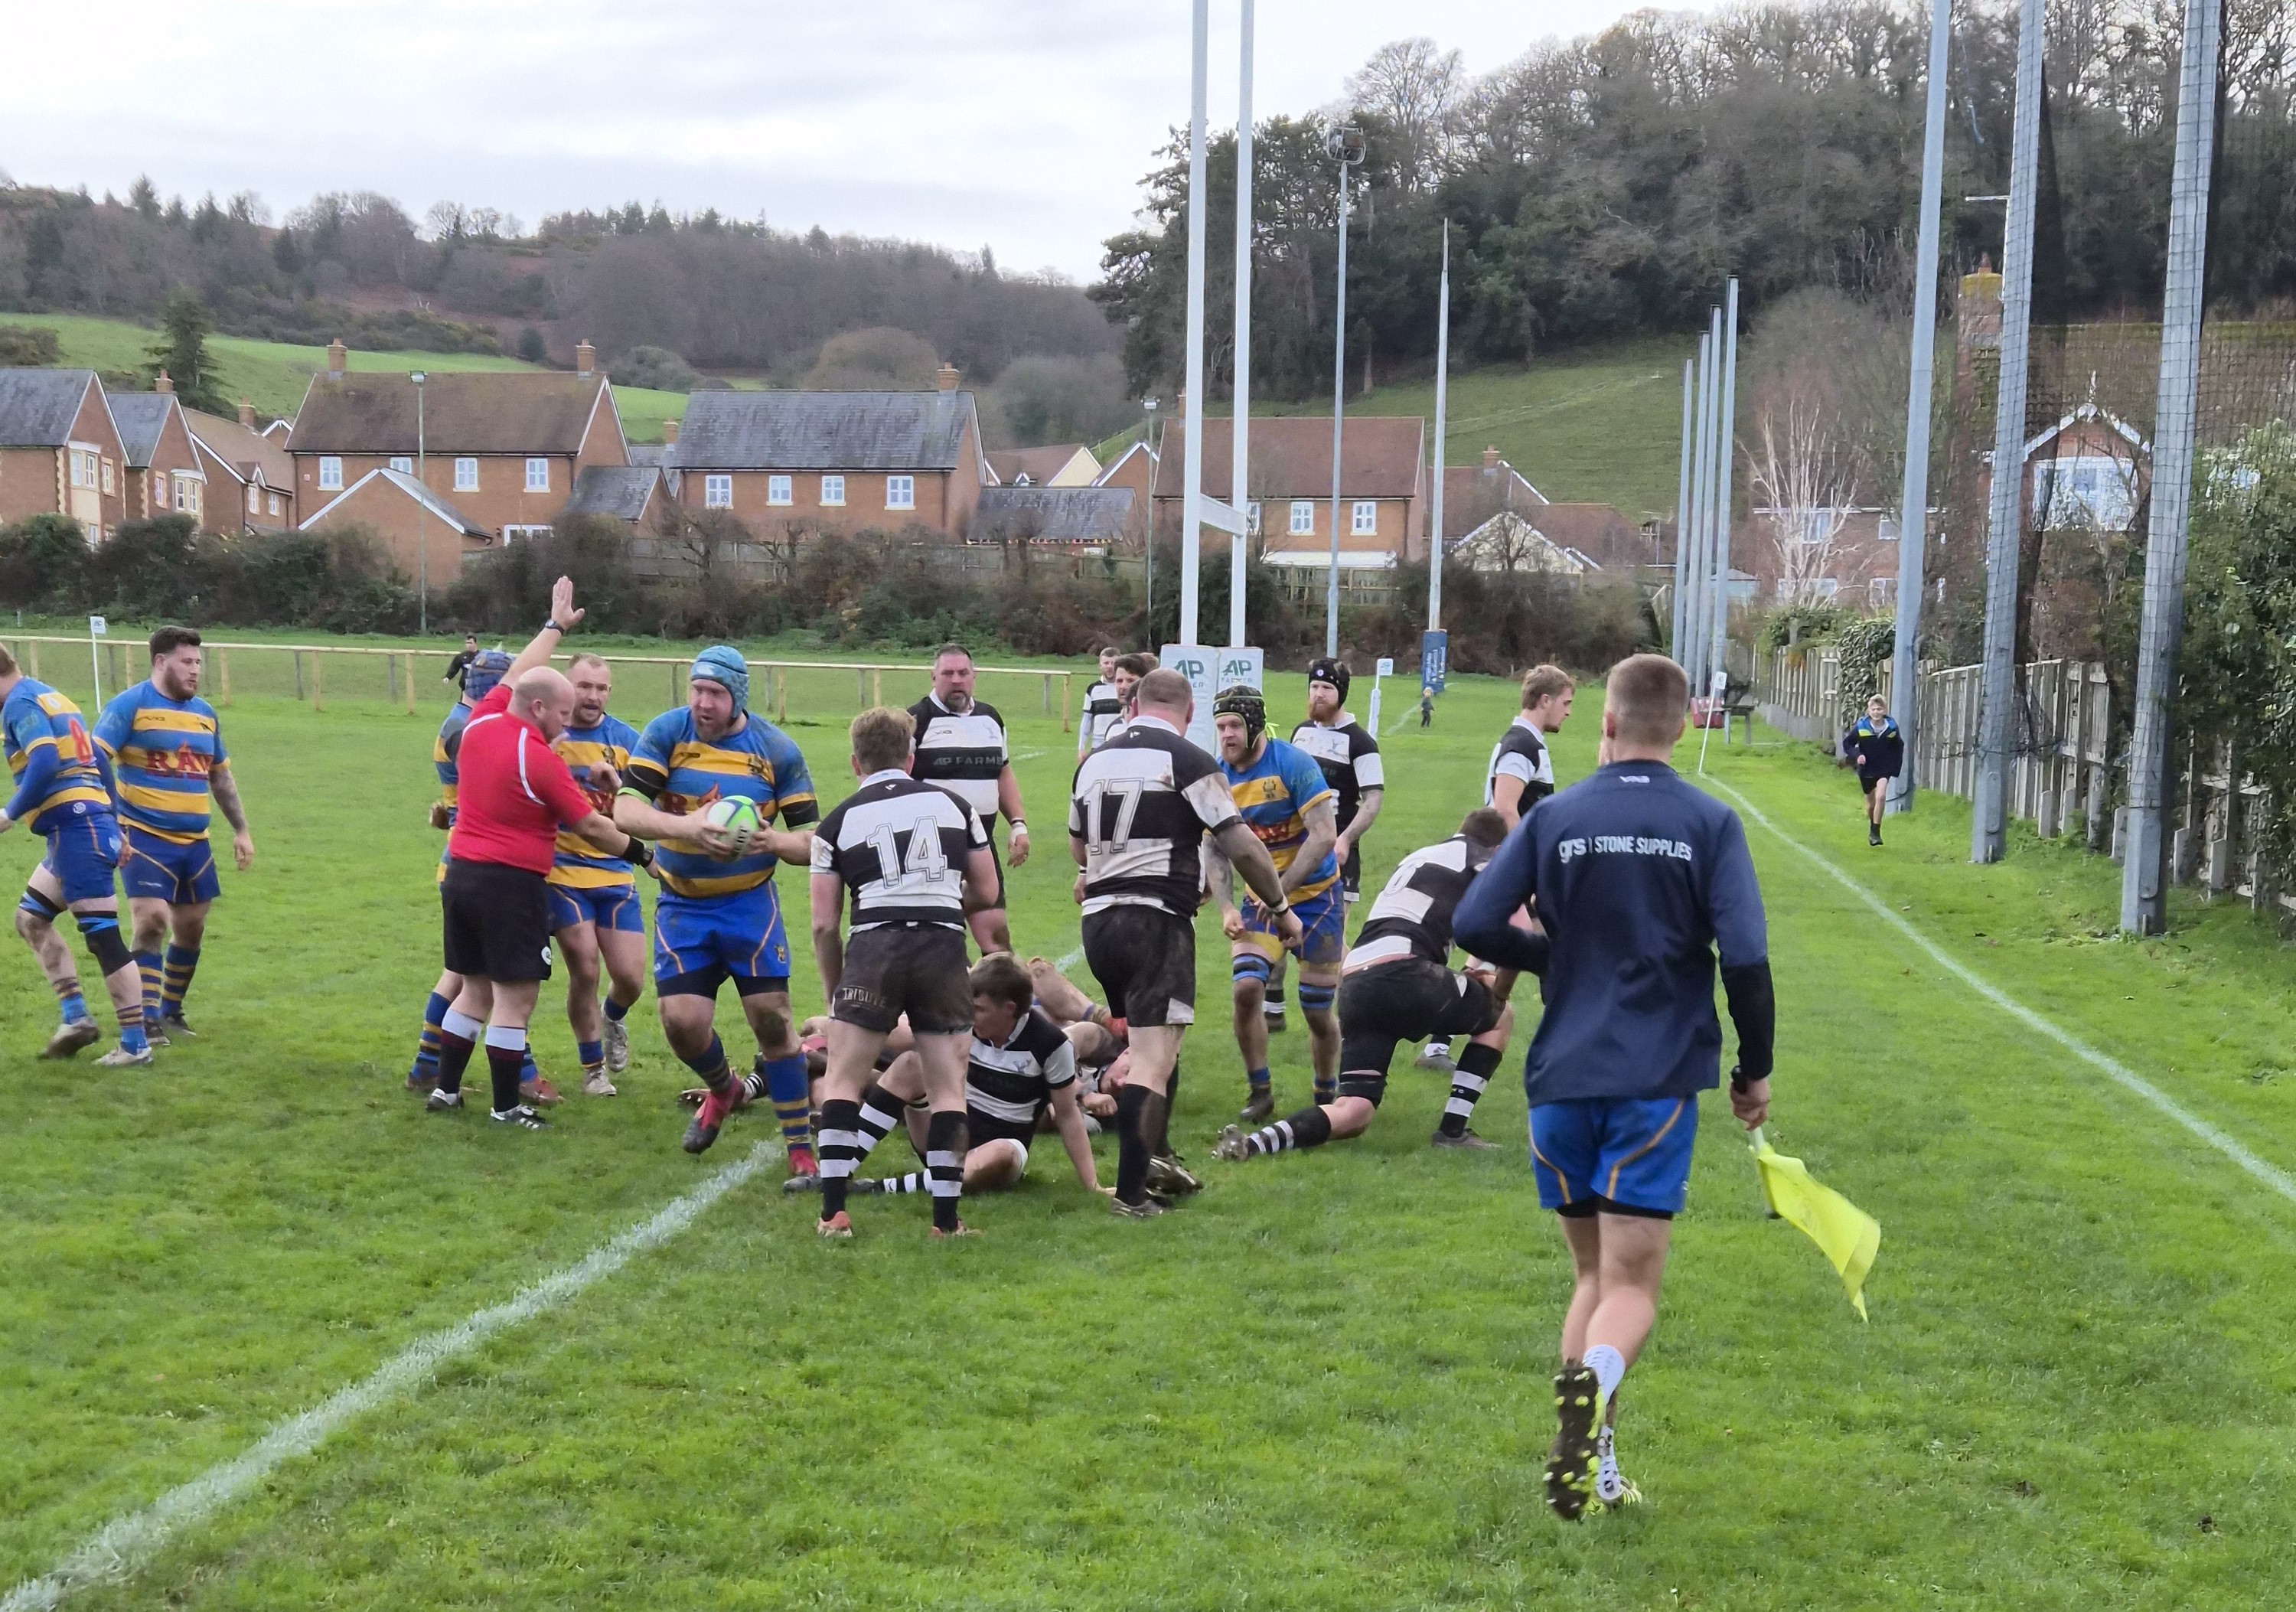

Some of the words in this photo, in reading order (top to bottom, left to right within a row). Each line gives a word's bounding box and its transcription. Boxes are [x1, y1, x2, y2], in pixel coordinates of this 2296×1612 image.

[1174, 659, 1205, 680] AP
[1221, 659, 1252, 677] AP
[69, 718, 92, 764] 8
[1082, 777, 1145, 856] 17
[865, 815, 948, 889] 14
[1594, 835, 1635, 854] STONE
[1636, 837, 1693, 862] SUPPLIES
